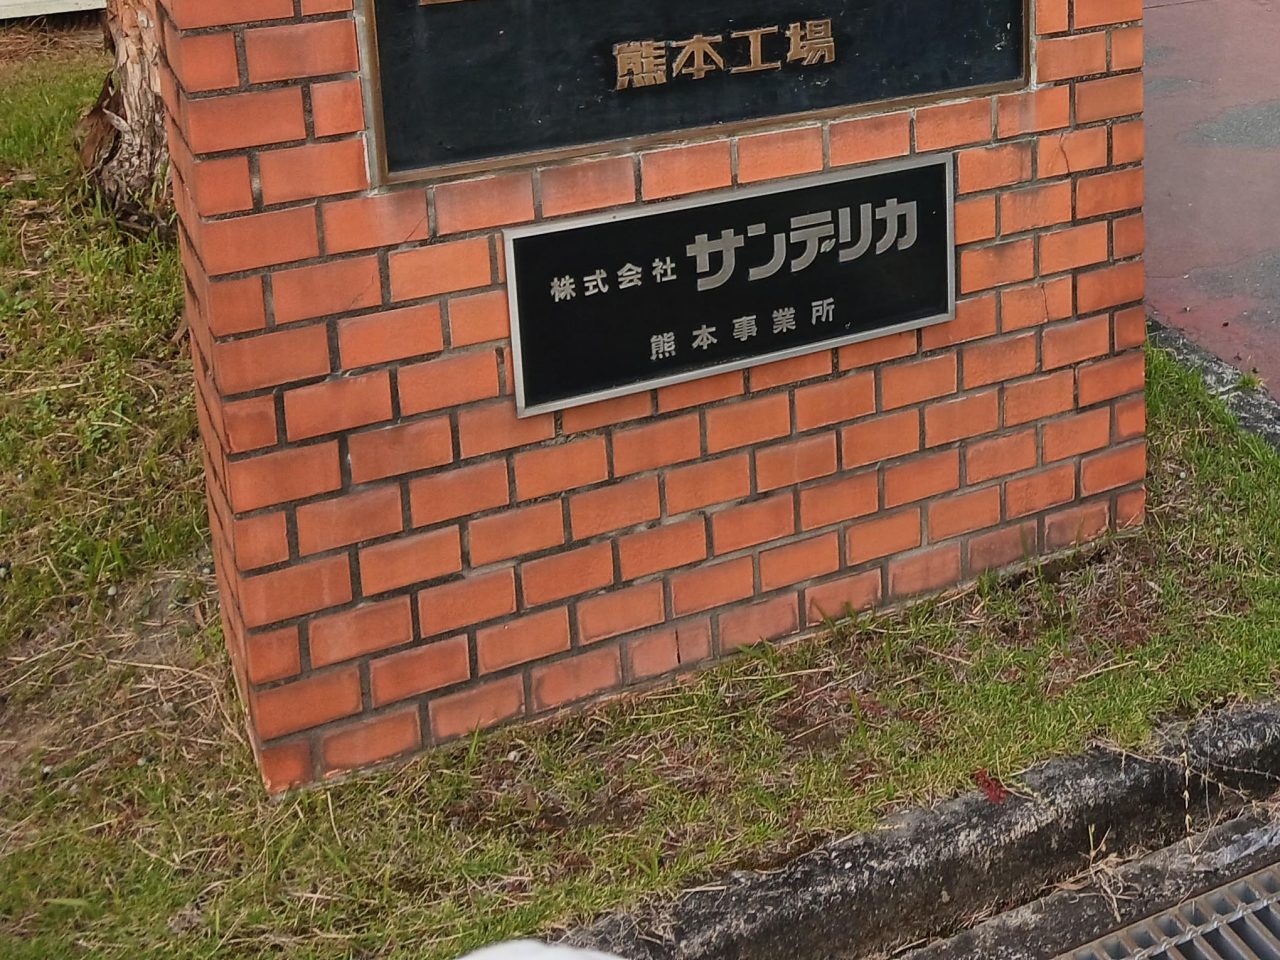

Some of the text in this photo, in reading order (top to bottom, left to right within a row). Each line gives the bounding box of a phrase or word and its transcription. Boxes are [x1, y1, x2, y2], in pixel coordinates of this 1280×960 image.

[613, 18, 837, 91] 熊本工場
[550, 197, 918, 303] 株式会社 サンデリカ
[649, 296, 836, 362] 熊本事業所
